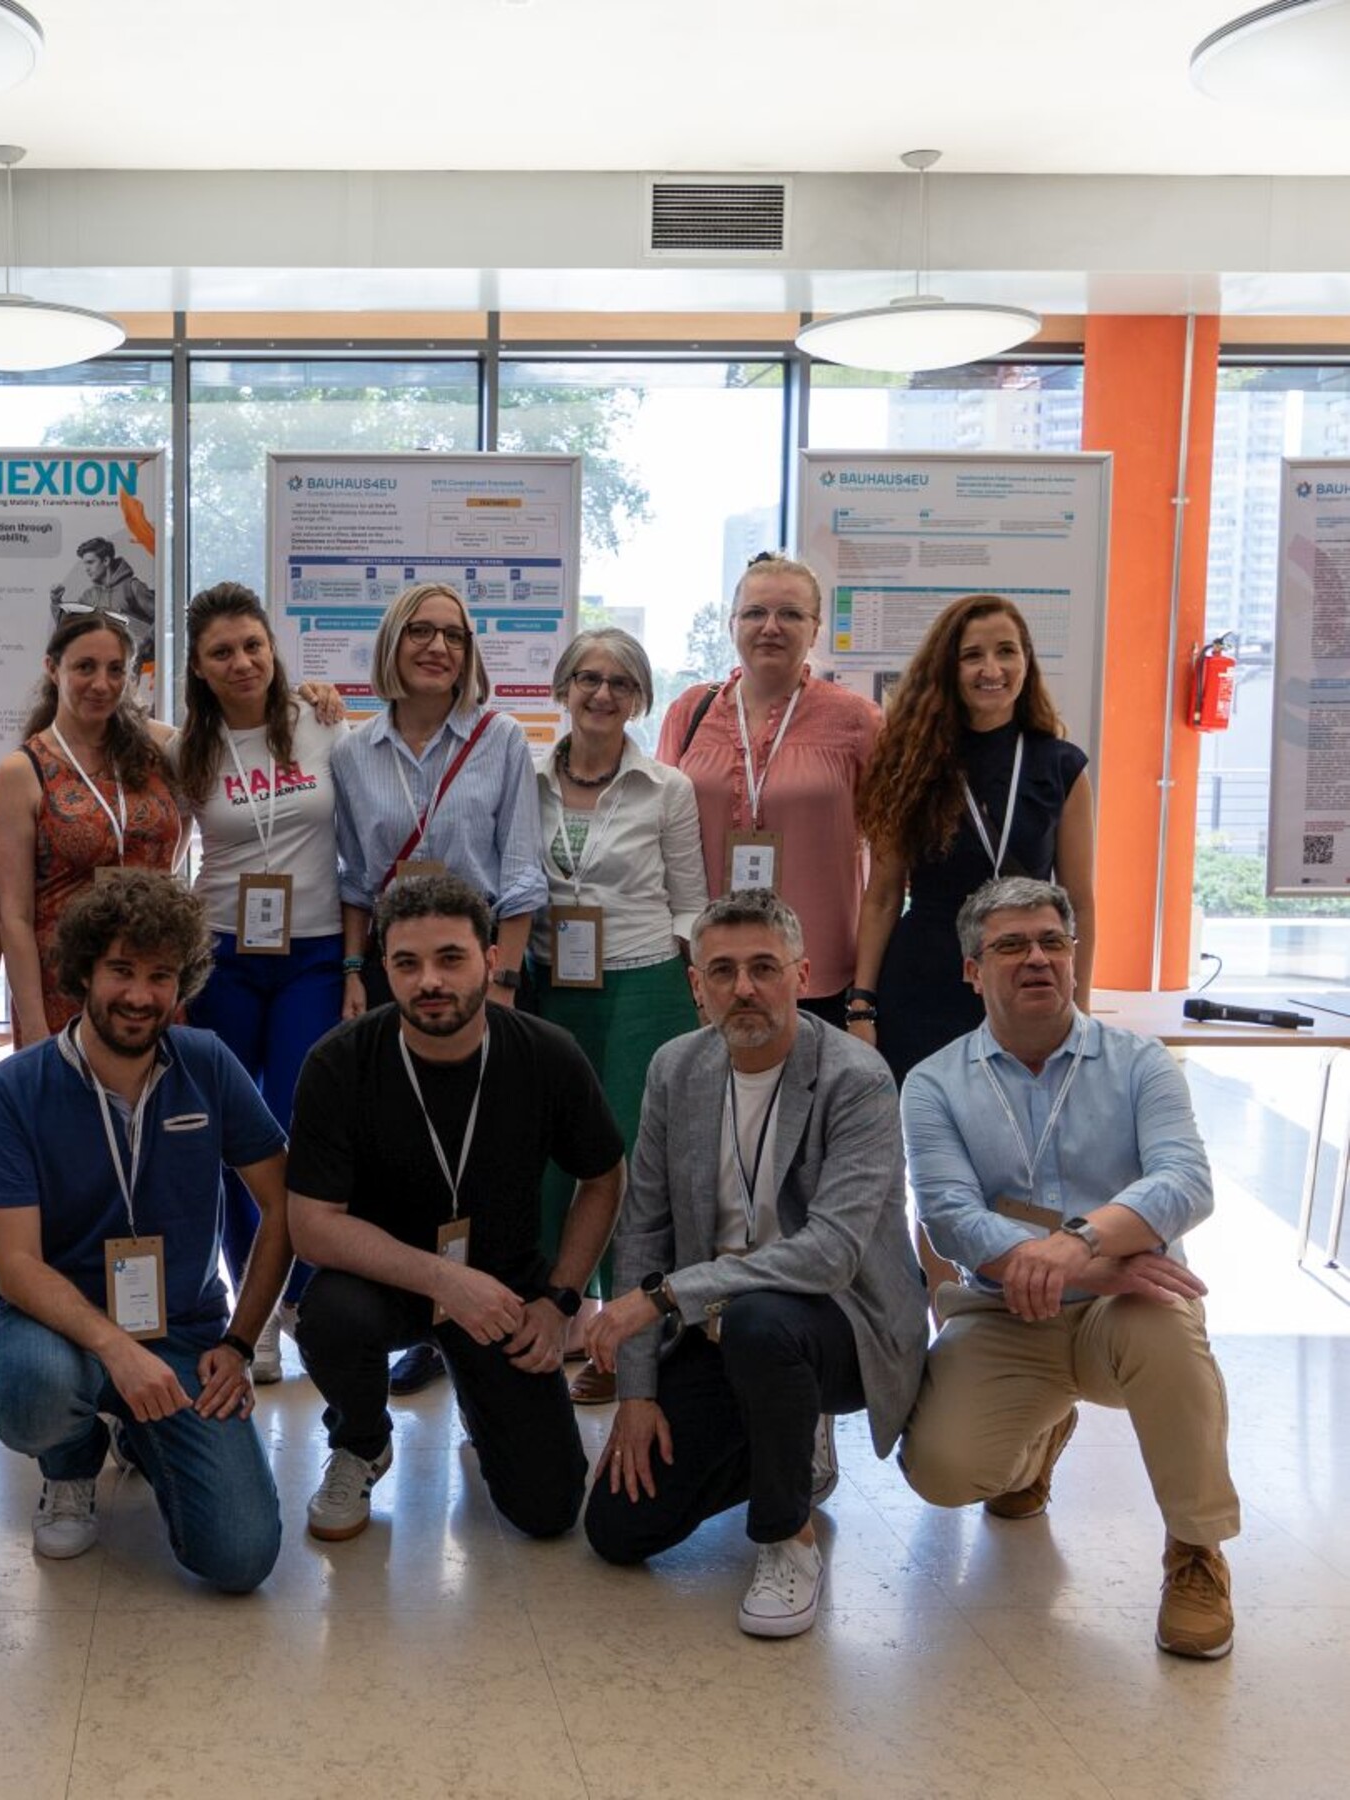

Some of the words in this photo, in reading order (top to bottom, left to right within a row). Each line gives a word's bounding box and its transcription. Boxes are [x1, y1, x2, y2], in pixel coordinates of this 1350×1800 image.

[307, 477, 398, 490] BAUHAUS4EU
[839, 472, 929, 486] BAUHAUS4EU
[17, 523, 53, 534] through
